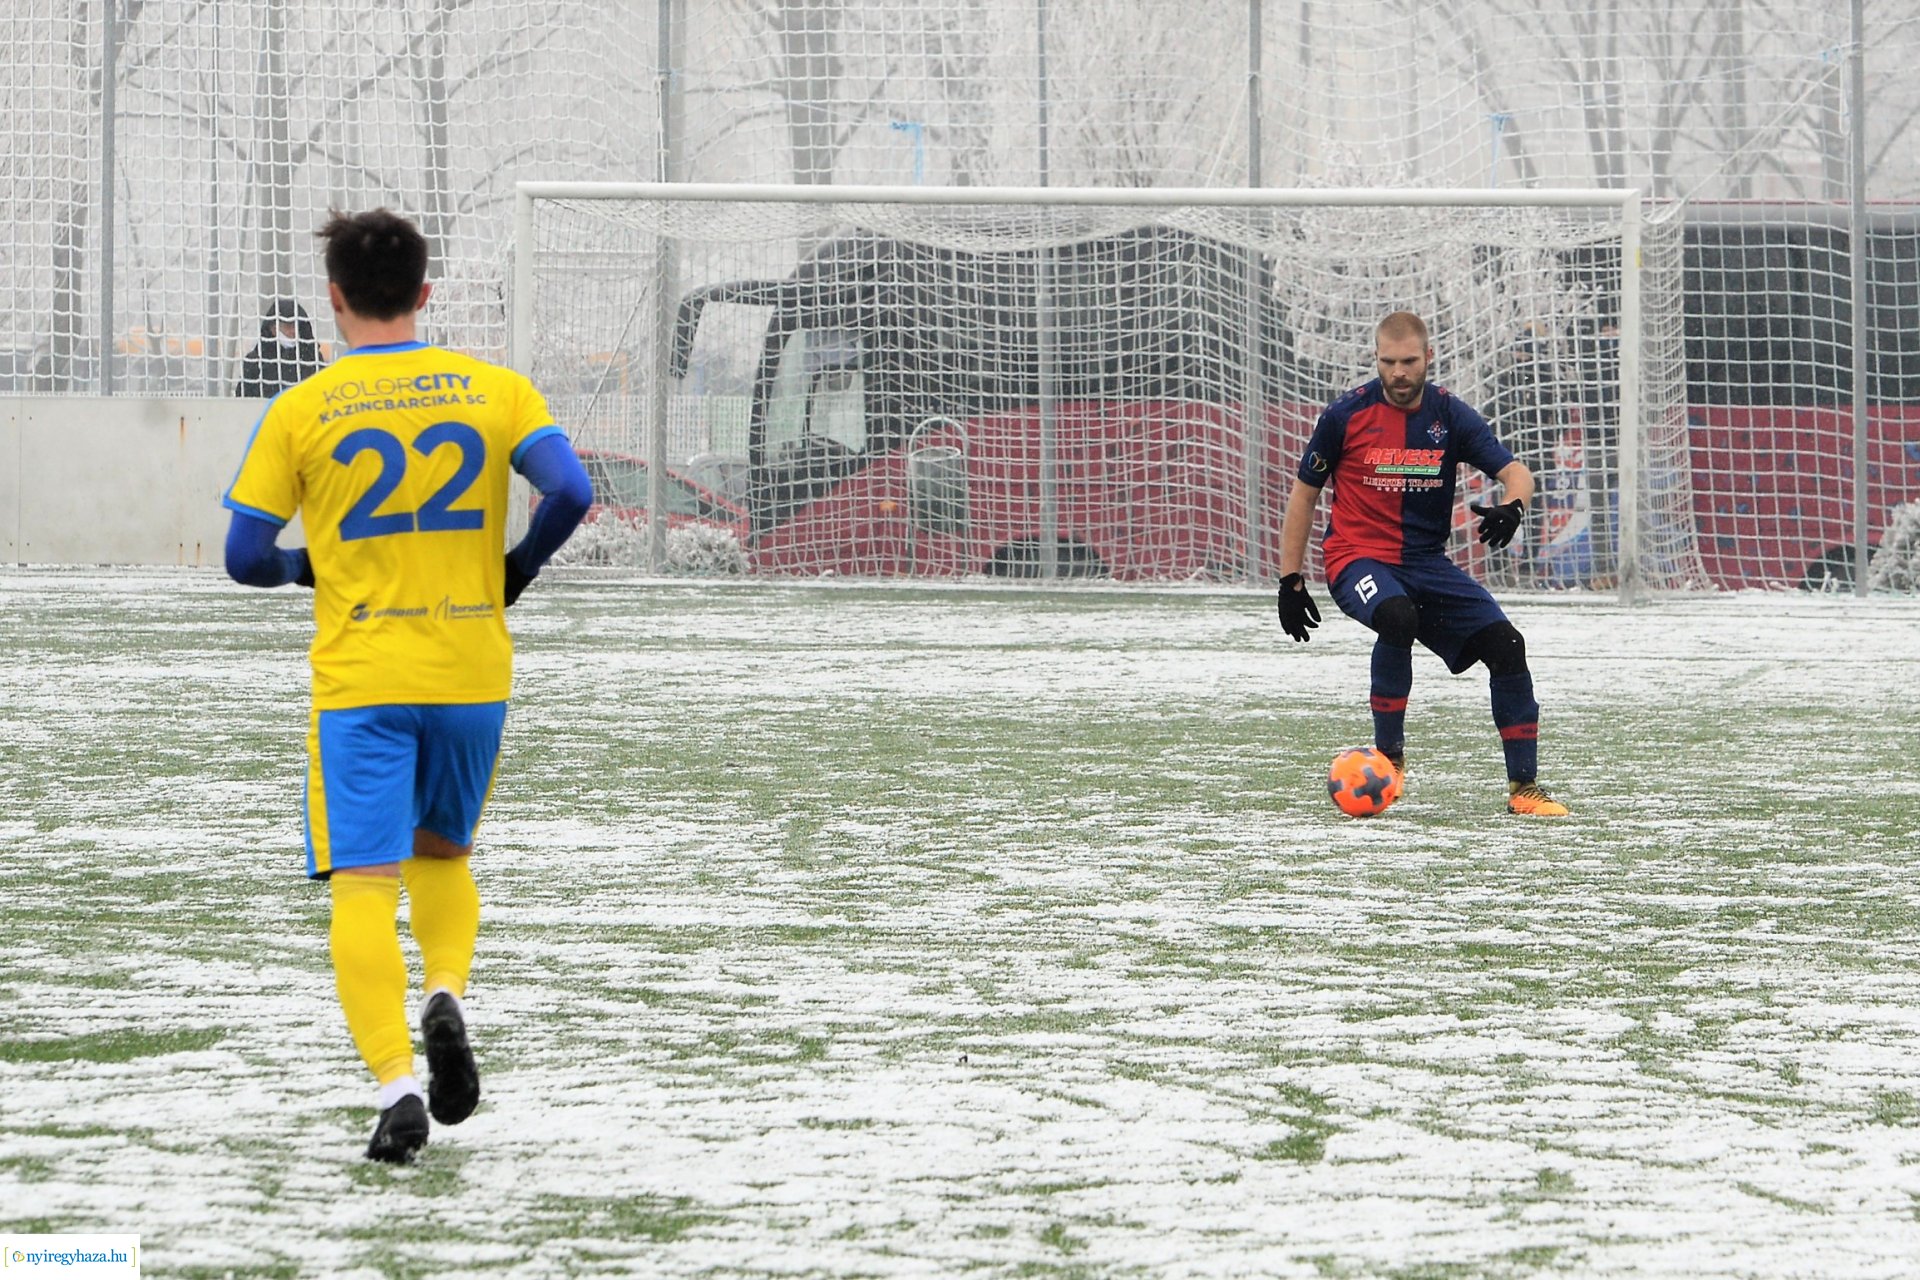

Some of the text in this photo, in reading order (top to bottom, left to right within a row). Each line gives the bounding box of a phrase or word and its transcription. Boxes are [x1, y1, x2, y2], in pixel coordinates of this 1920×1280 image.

[322, 373, 472, 405] KOLORCITY
[319, 393, 487, 425] KAZINCBARCIKA SC
[331, 421, 486, 542] 22
[1354, 574, 1378, 604] 15
